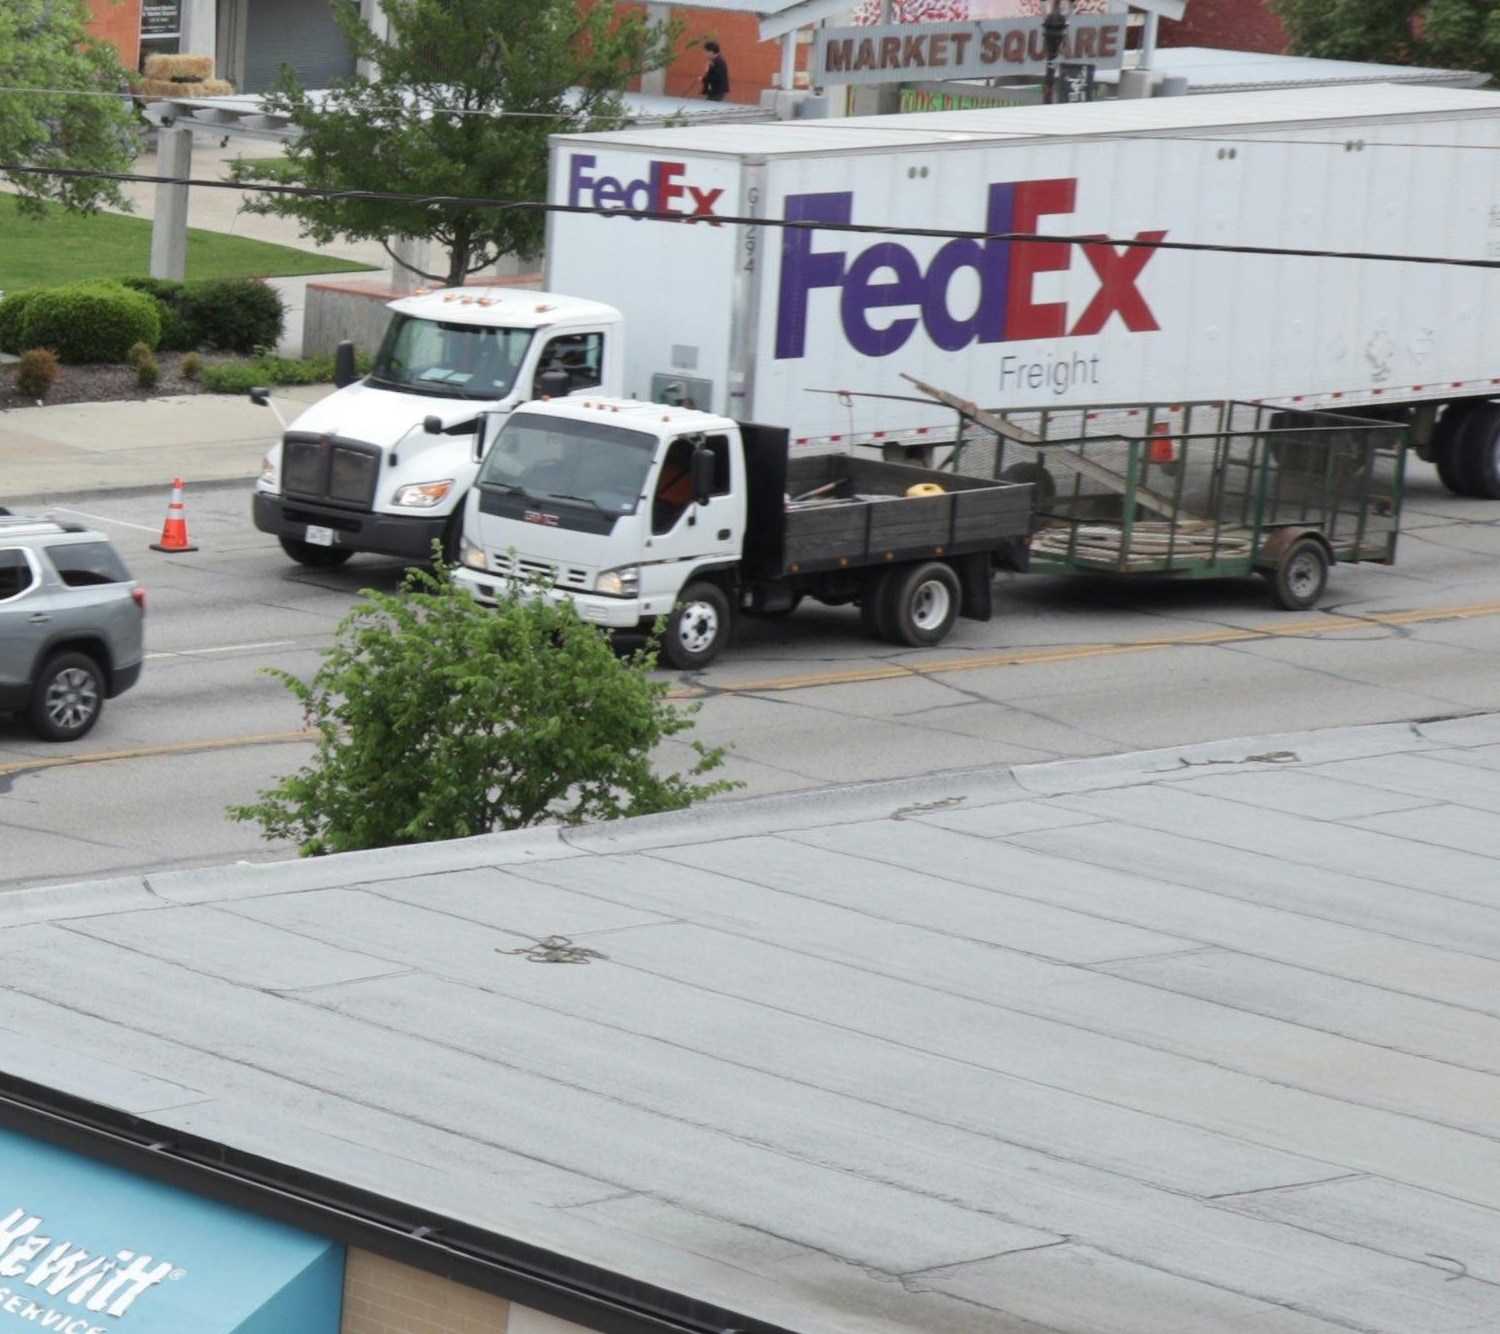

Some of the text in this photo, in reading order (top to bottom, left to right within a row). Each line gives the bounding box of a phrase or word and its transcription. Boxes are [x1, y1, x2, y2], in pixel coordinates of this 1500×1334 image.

[824, 24, 1120, 73] MARKET SQUARE
[568, 153, 726, 228] FedEx
[774, 177, 1170, 360] FedEx
[999, 350, 1100, 396] Freight
